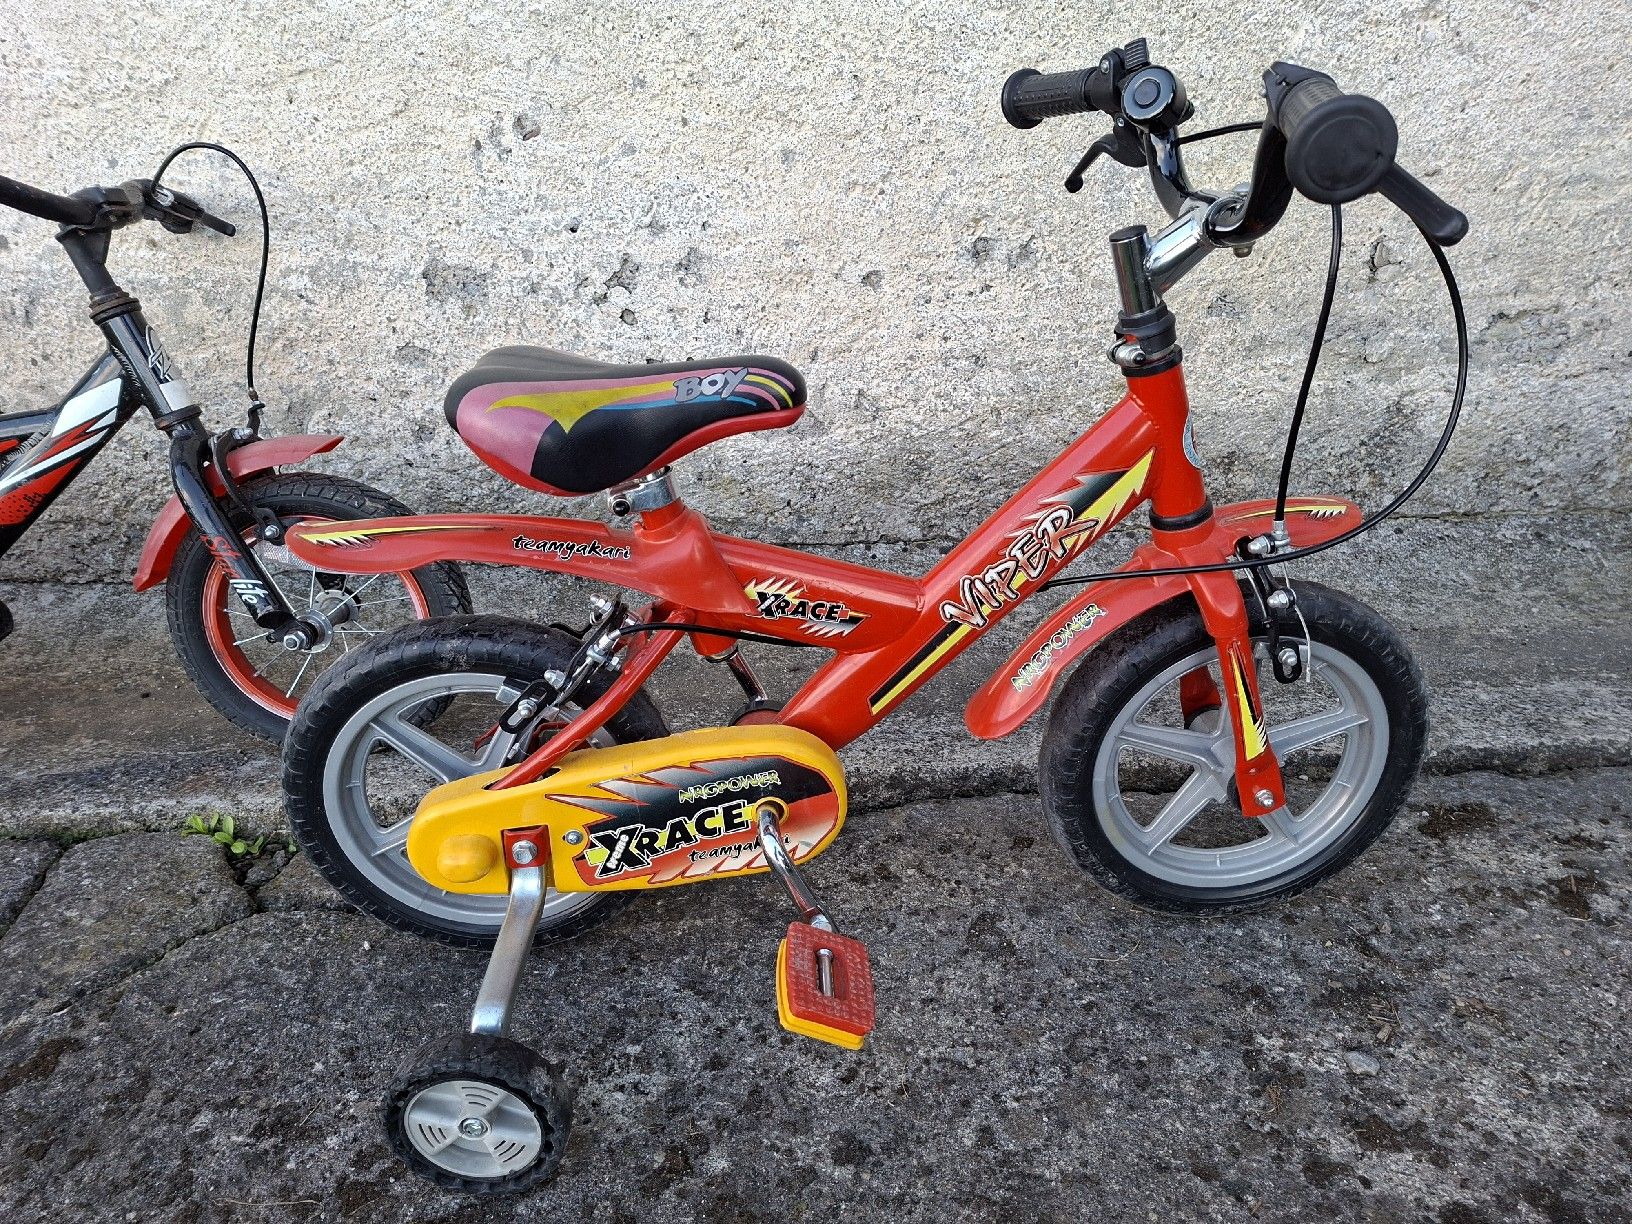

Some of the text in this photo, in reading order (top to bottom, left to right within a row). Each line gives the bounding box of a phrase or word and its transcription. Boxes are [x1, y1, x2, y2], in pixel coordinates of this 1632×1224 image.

[673, 367, 749, 402] BOY
[512, 534, 630, 560] teamyakari
[940, 505, 1101, 630] VIPER
[756, 591, 843, 622] XRACE
[678, 770, 782, 804] NRGPOWER
[590, 800, 751, 878] XRACE
